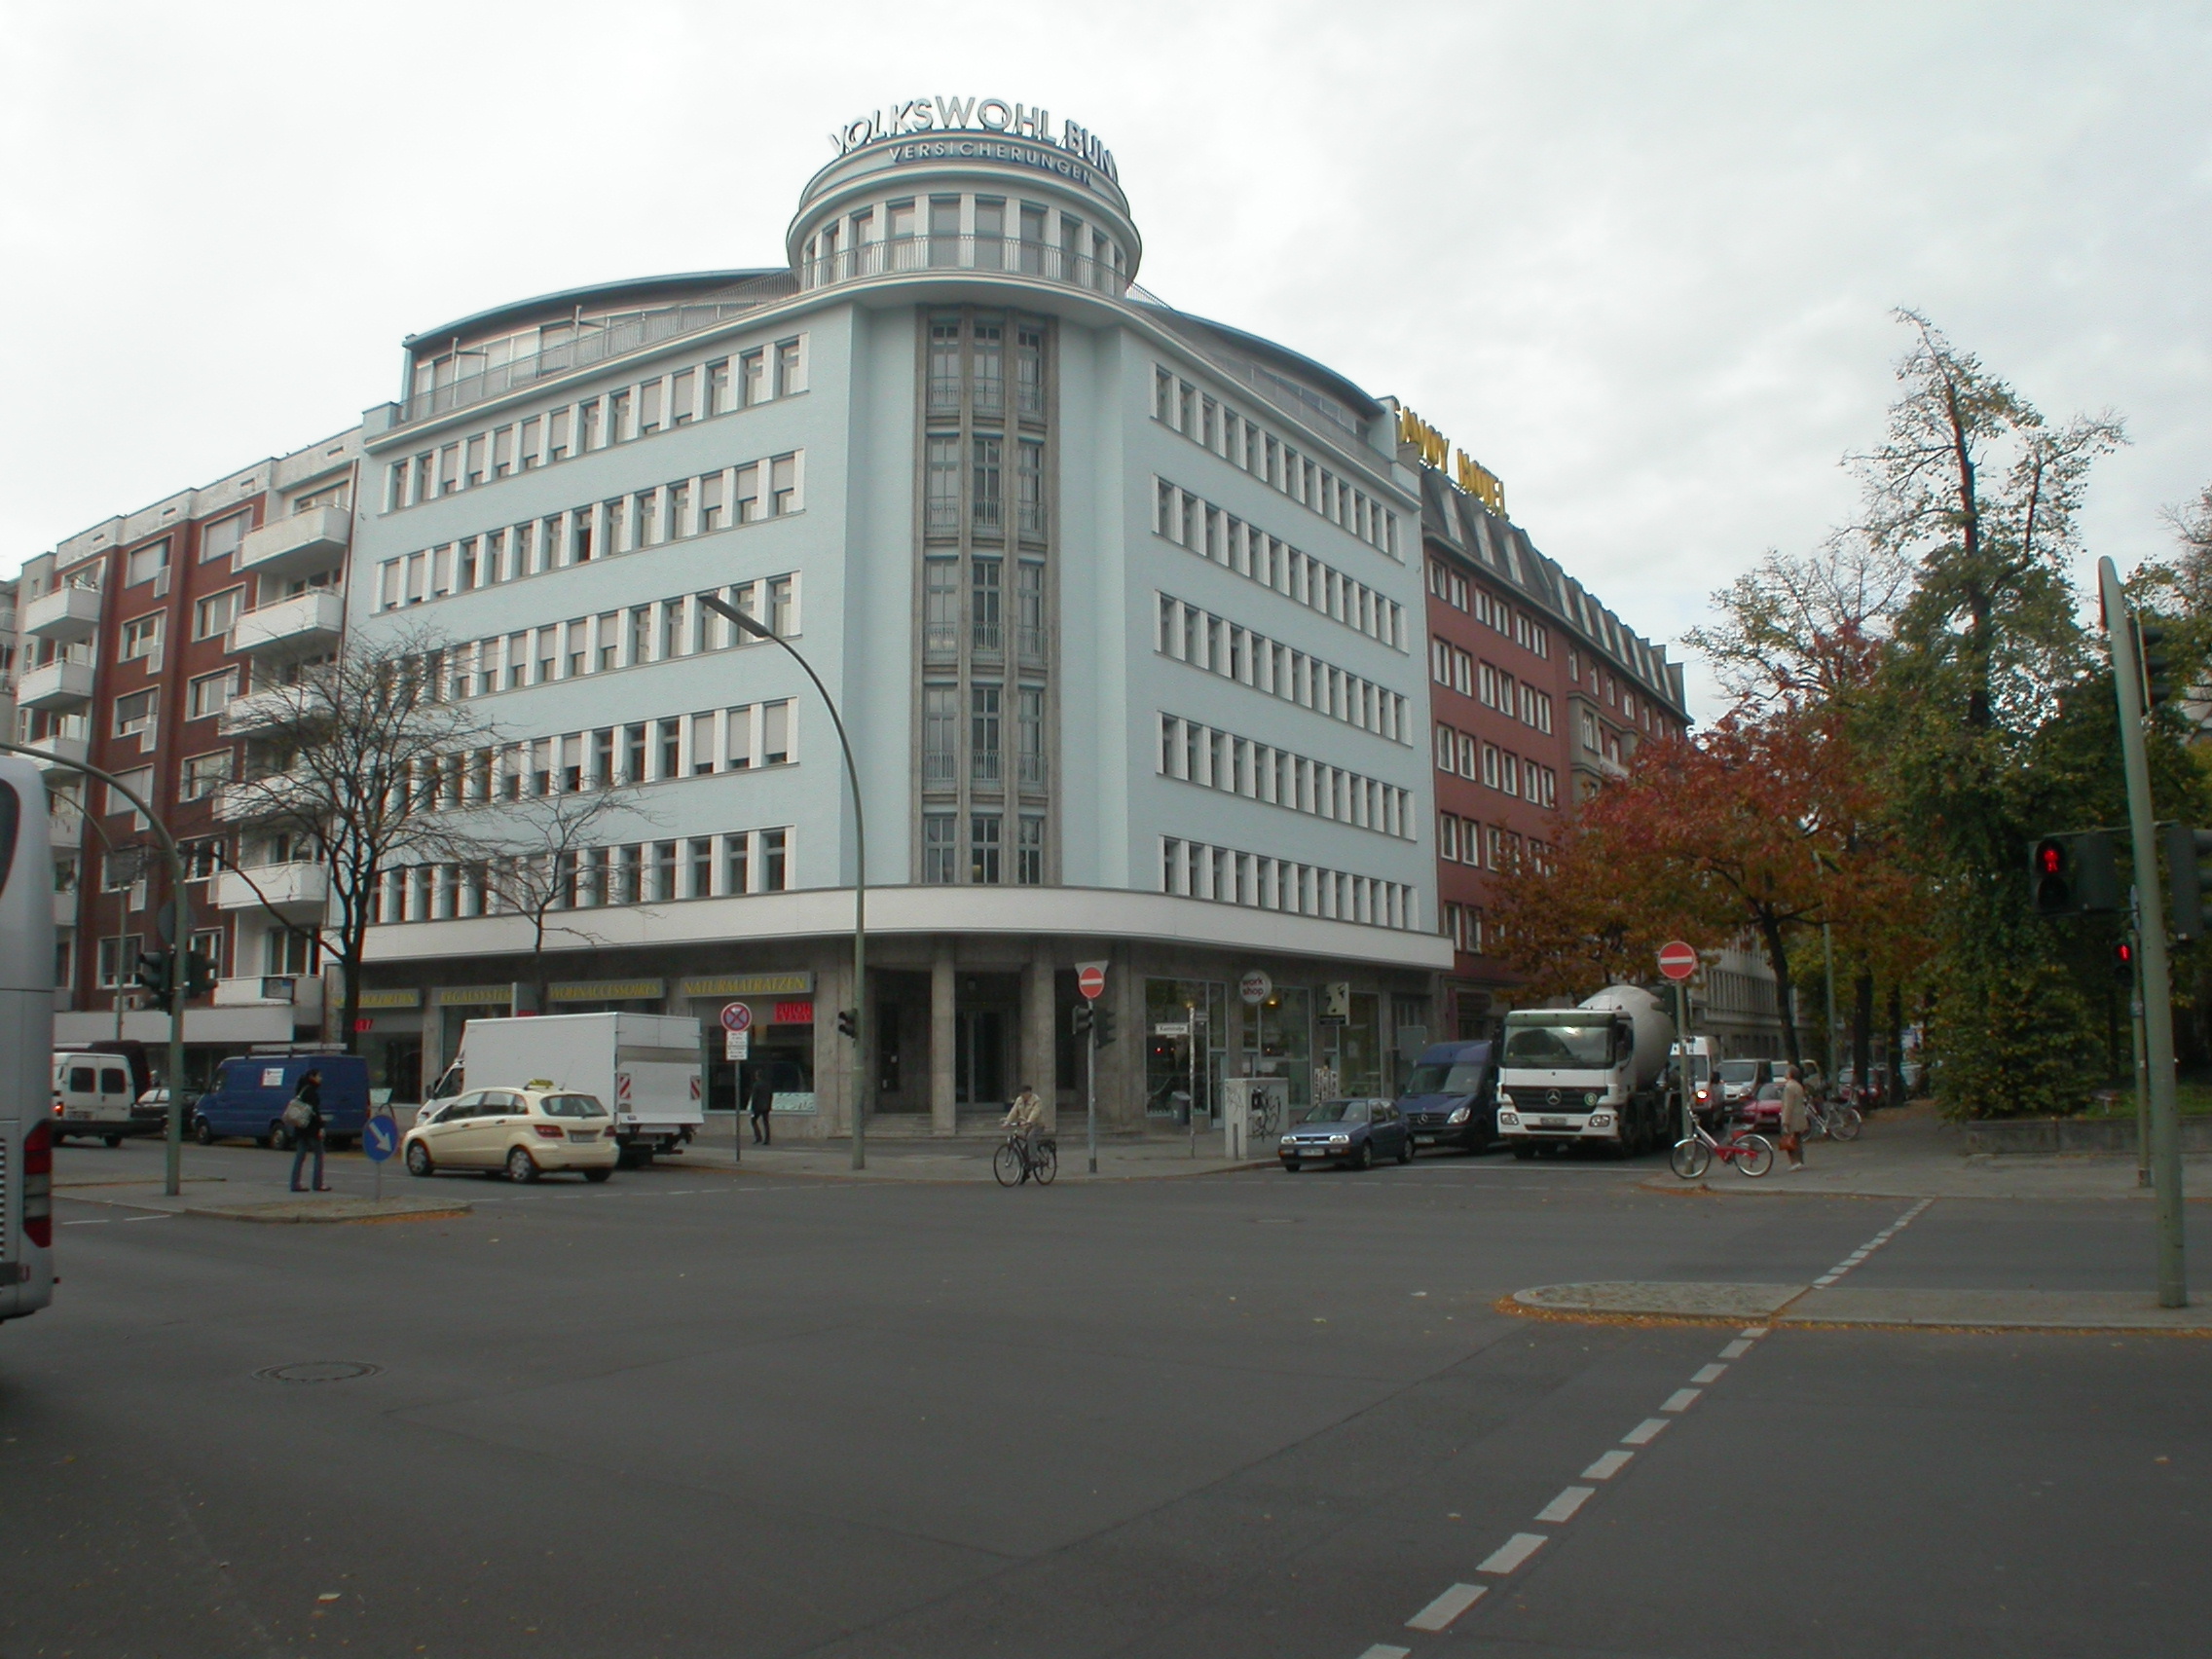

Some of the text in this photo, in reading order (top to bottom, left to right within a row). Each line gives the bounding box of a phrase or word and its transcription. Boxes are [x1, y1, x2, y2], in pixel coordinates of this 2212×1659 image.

[828, 95, 1056, 156] VOLKSWOHL
[889, 142, 1092, 185] VERSICHERUNGEN
[684, 977, 806, 994] NATURMATRATZEN
[1242, 977, 1264, 986] work
[1242, 986, 1264, 996] shop
